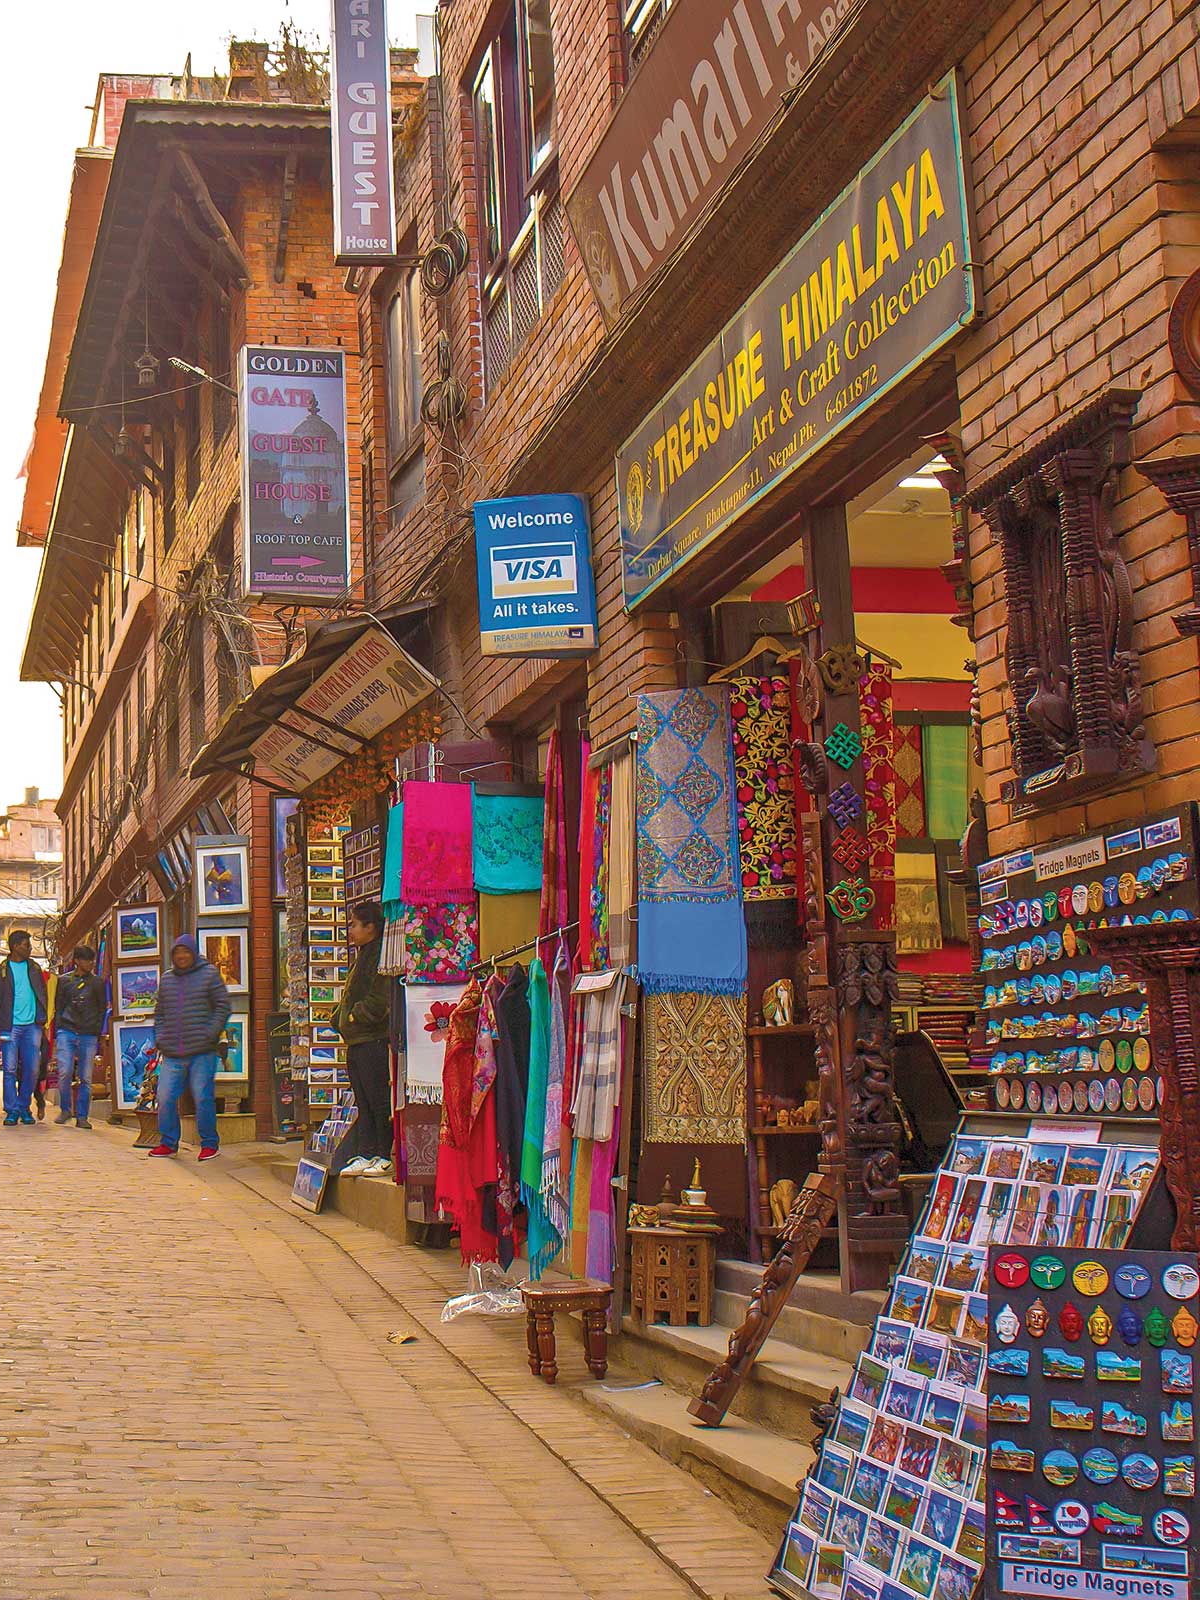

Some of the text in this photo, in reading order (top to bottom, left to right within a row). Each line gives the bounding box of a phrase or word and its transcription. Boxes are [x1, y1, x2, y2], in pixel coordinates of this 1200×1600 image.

[785, 52, 802, 87] &
[348, 82, 379, 226] GUEST
[346, 235, 388, 250] House
[654, 330, 766, 494] TREASURE
[779, 148, 945, 370] HIMALAYA
[752, 405, 776, 452] Art
[779, 387, 794, 425] &
[797, 340, 841, 407] Craft
[844, 241, 957, 360] Collection
[250, 355, 338, 374] GOLDEN
[251, 386, 315, 407] GATE
[253, 435, 328, 454] GUEST
[648, 551, 672, 578] Durbar
[705, 467, 763, 528] Bhaktapur-11,
[768, 433, 798, 473] Nepal
[800, 421, 817, 446] Ph:
[825, 364, 878, 422] 6-611872
[255, 482, 332, 501] HOUSE
[293, 514, 303, 525] &
[488, 512, 574, 530] Welcome
[255, 534, 343, 546] ROOF TOP CAFE
[254, 572, 345, 585] Historic Courtyard
[504, 559, 563, 582] VISA
[493, 601, 579, 618] All it takes.
[494, 629, 569, 643] TREASURE HIMALAYA
[360, 678, 390, 704] PAPER
[1039, 850, 1100, 877] Fridge Magnets
[1012, 1565, 1175, 1596] Fridge Magnets
